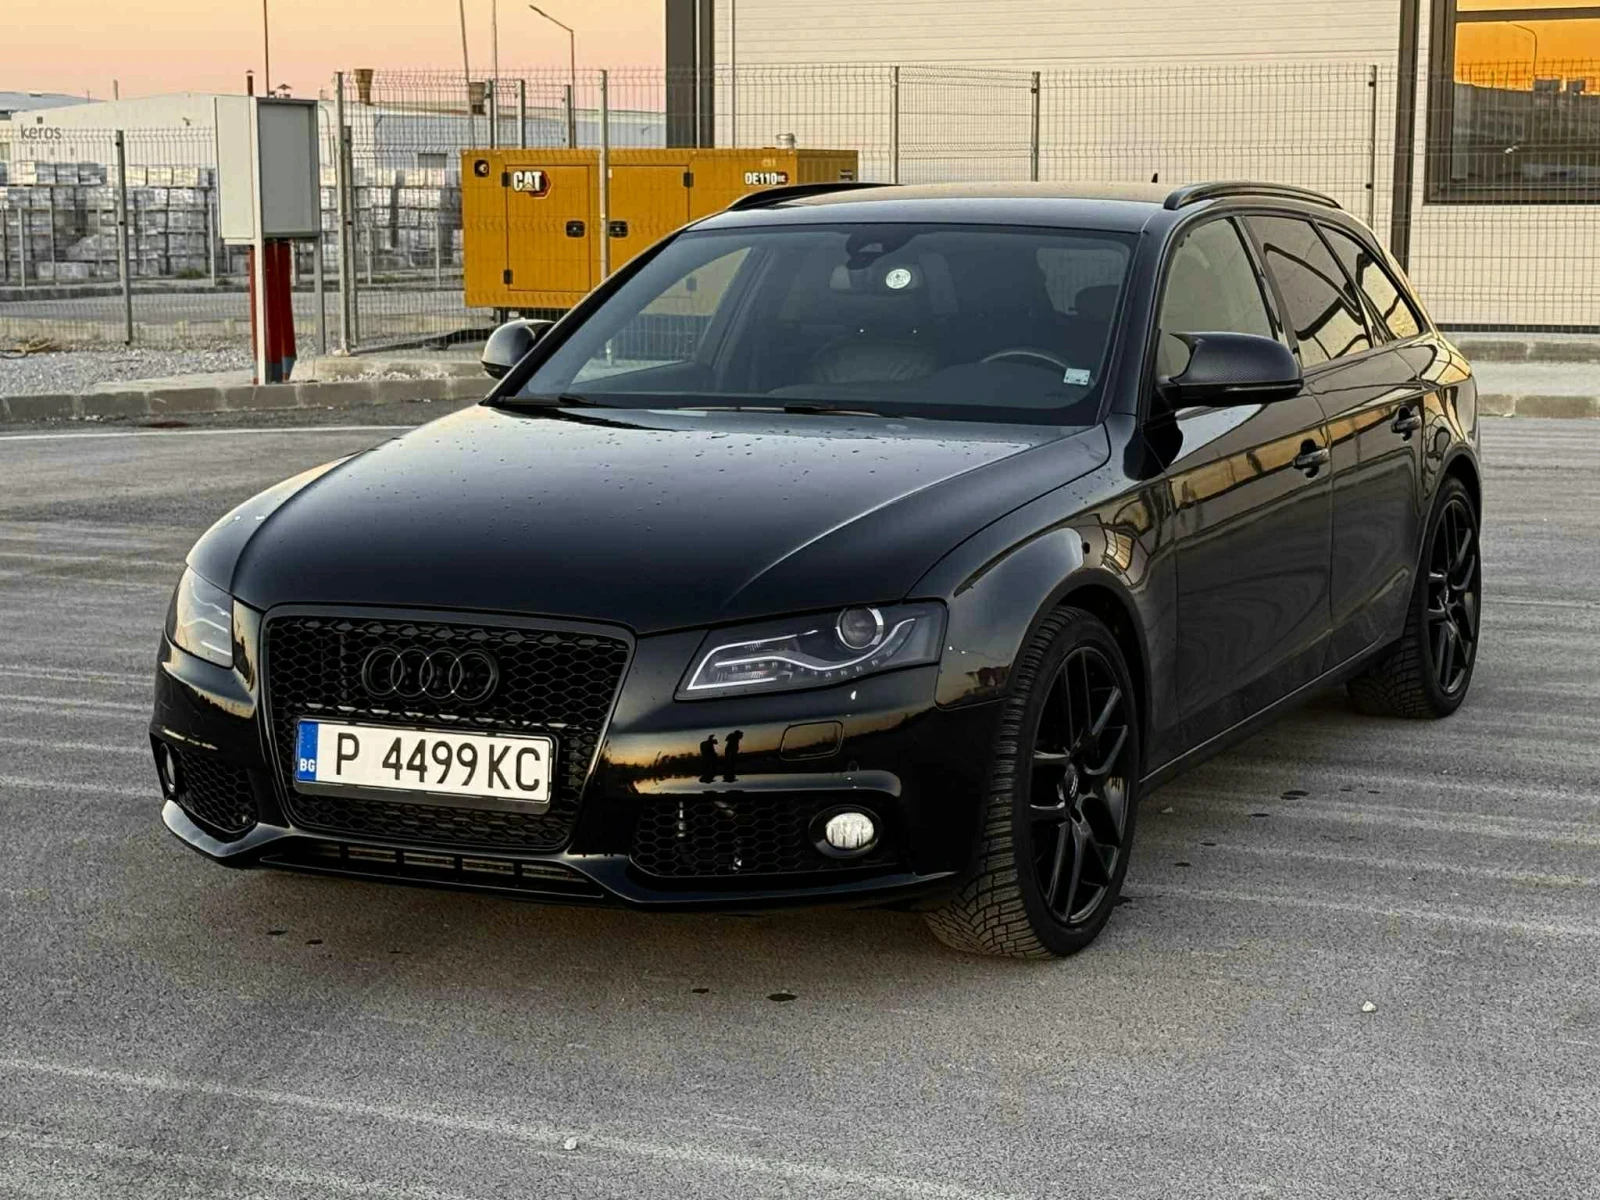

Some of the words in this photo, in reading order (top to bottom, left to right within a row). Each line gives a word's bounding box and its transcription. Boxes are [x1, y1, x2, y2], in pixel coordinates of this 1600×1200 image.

[20, 124, 62, 139] keros
[513, 170, 542, 192] CAT
[336, 732, 360, 776] P
[299, 758, 316, 773] BG
